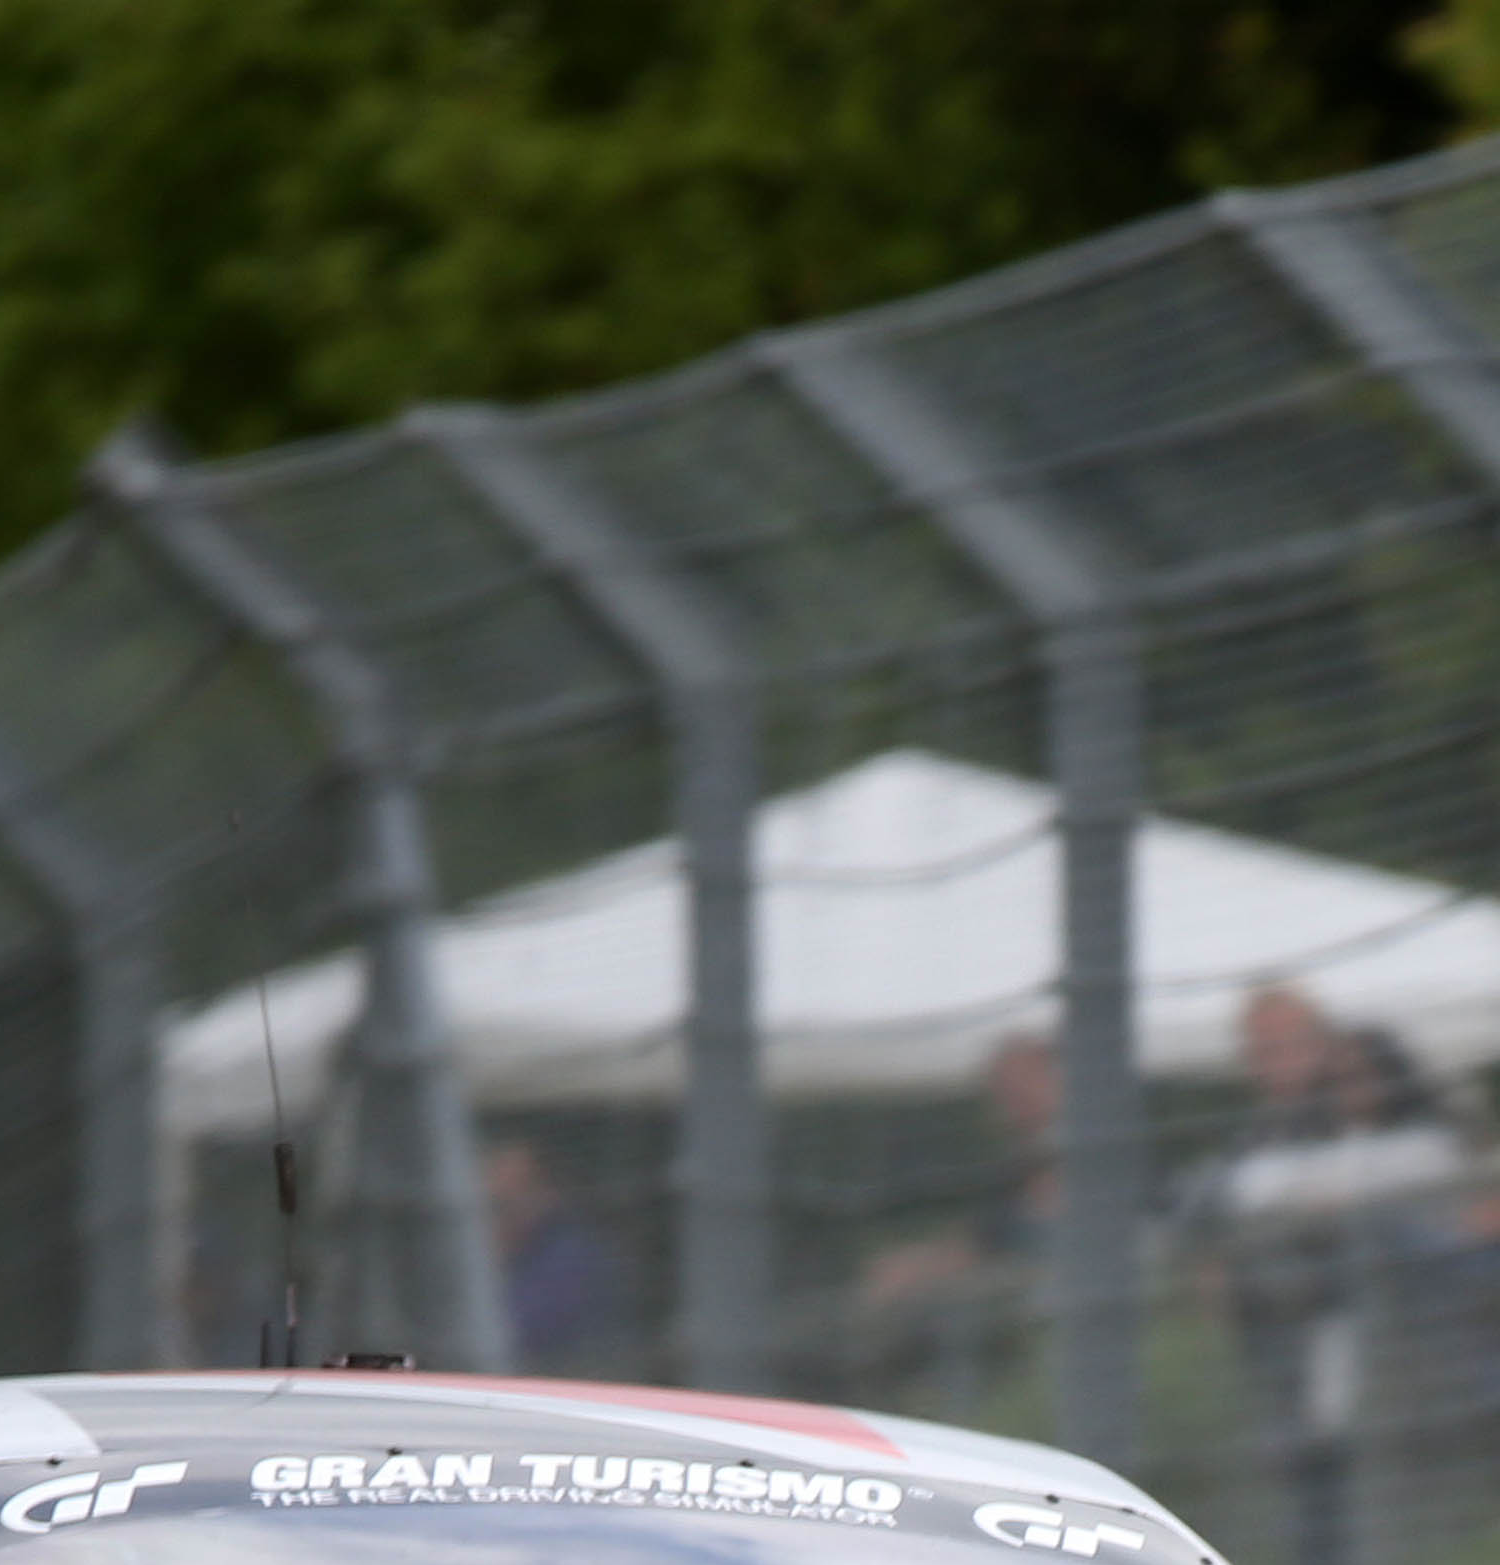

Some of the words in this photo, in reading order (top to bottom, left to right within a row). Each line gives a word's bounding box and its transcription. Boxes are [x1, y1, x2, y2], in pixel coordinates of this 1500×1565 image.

[250, 1454, 494, 1491] GRAN
[518, 1454, 903, 1513] TURISMO
[251, 1490, 339, 1508] THE
[348, 1487, 463, 1505] REAL
[466, 1486, 646, 1507] DRIVING
